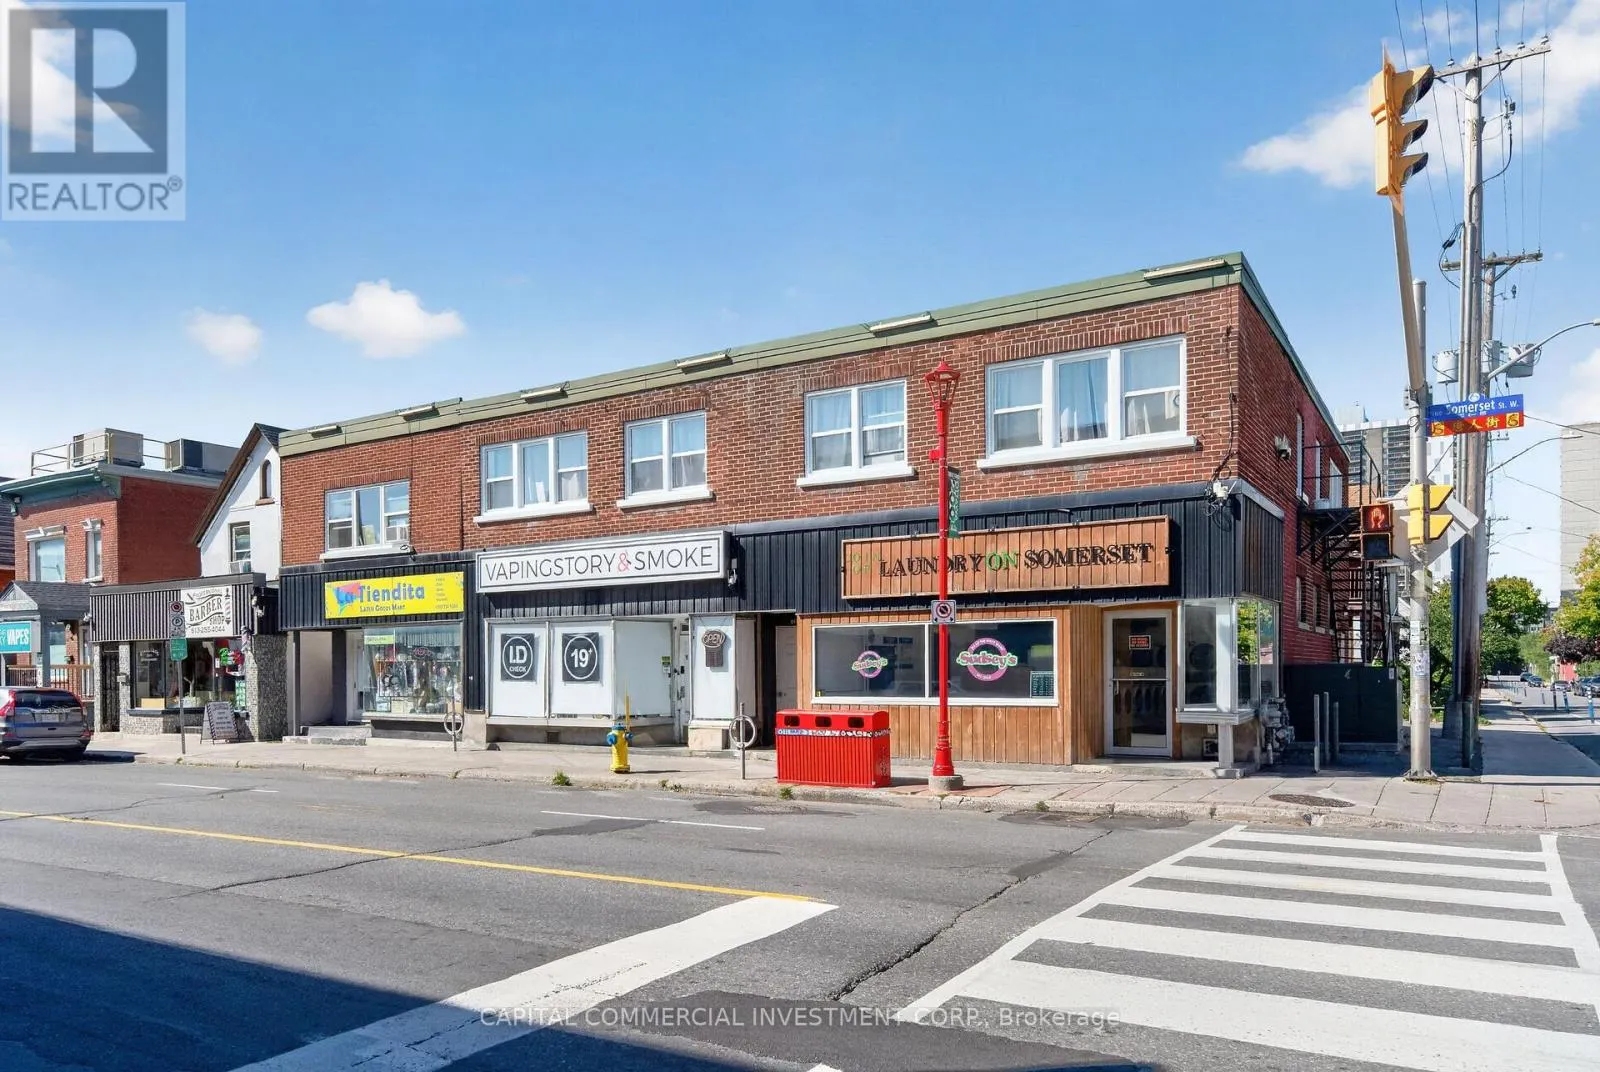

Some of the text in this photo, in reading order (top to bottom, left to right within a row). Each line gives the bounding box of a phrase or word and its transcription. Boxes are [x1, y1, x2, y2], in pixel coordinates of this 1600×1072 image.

[1446, 400, 1496, 415] Somerset
[1510, 400, 1519, 408] W.
[986, 549, 1019, 571] ON
[1024, 543, 1154, 570] SOMERSET
[358, 582, 426, 603] Tiendita
[189, 597, 223, 622] BARBER
[209, 615, 225, 625] SHOP
[7, 628, 30, 646] VAPES
[703, 632, 725, 646] OPEN
[571, 648, 593, 668] 19+
[957, 651, 1018, 670] Sudsey's
